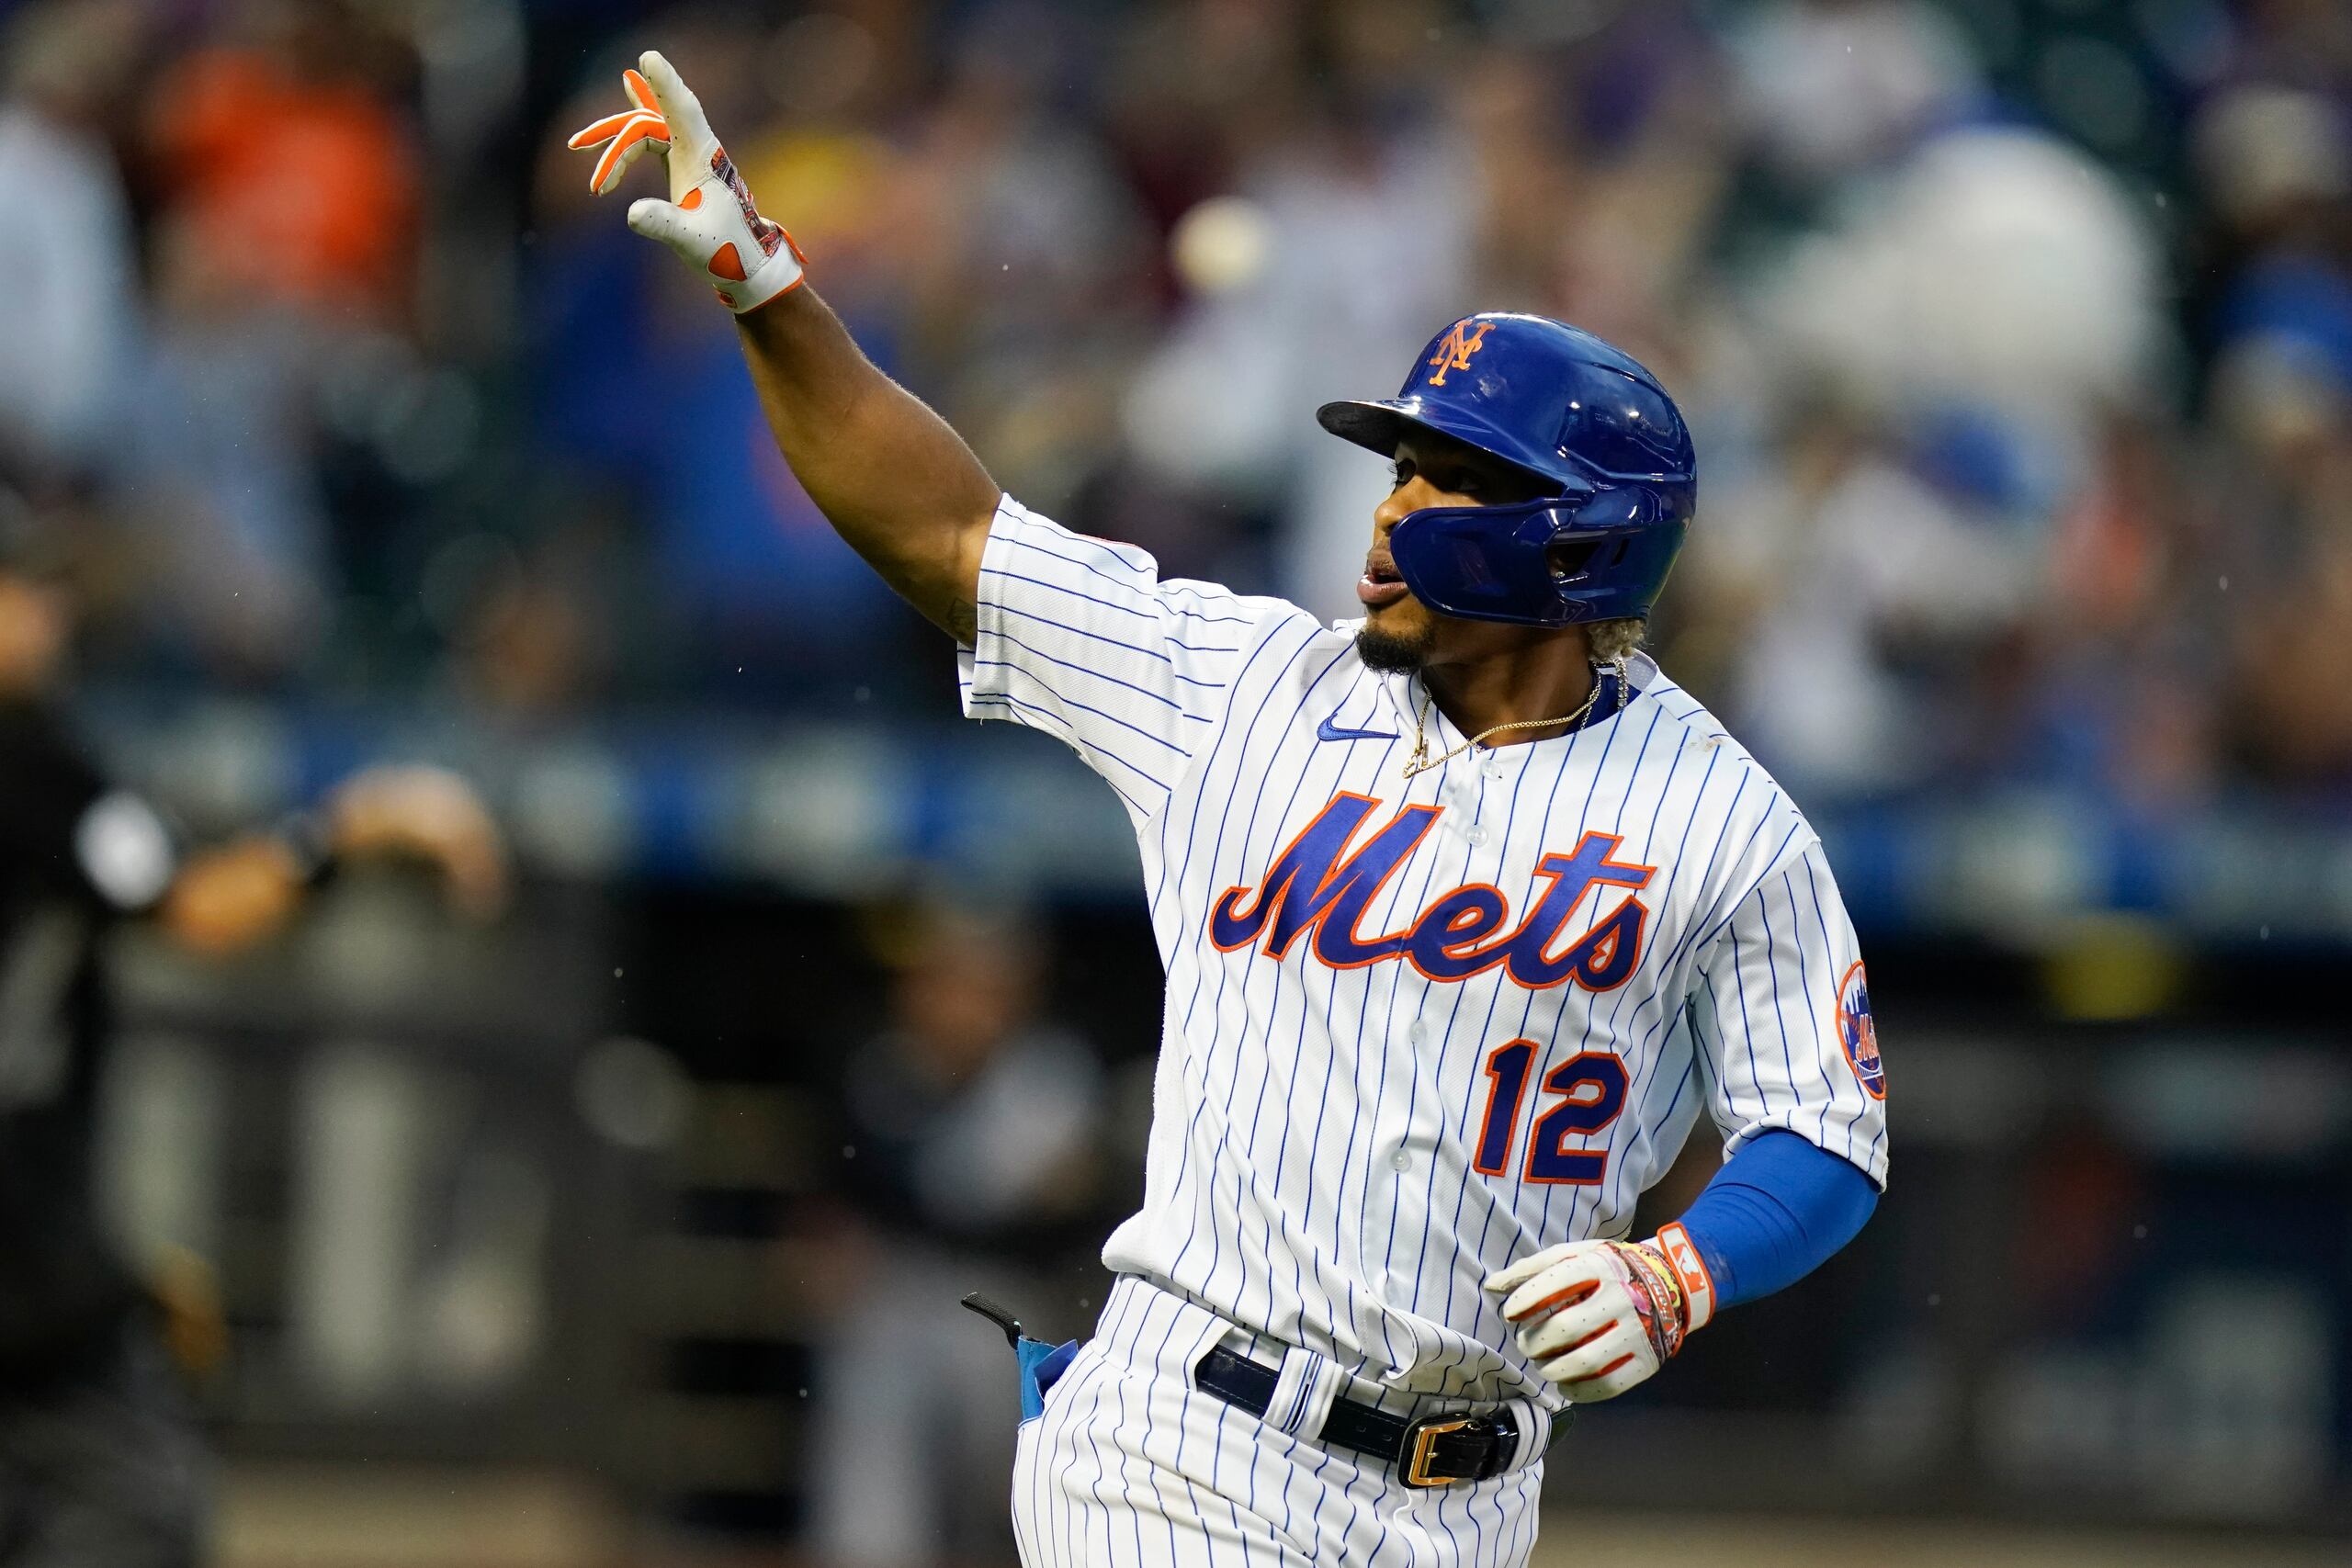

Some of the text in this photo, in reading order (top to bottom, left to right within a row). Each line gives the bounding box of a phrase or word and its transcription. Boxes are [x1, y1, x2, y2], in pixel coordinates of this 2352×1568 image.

[1210, 790, 1657, 993] Mets
[1855, 1013, 1880, 1062] Me
[1473, 1038, 1631, 1186] 12
